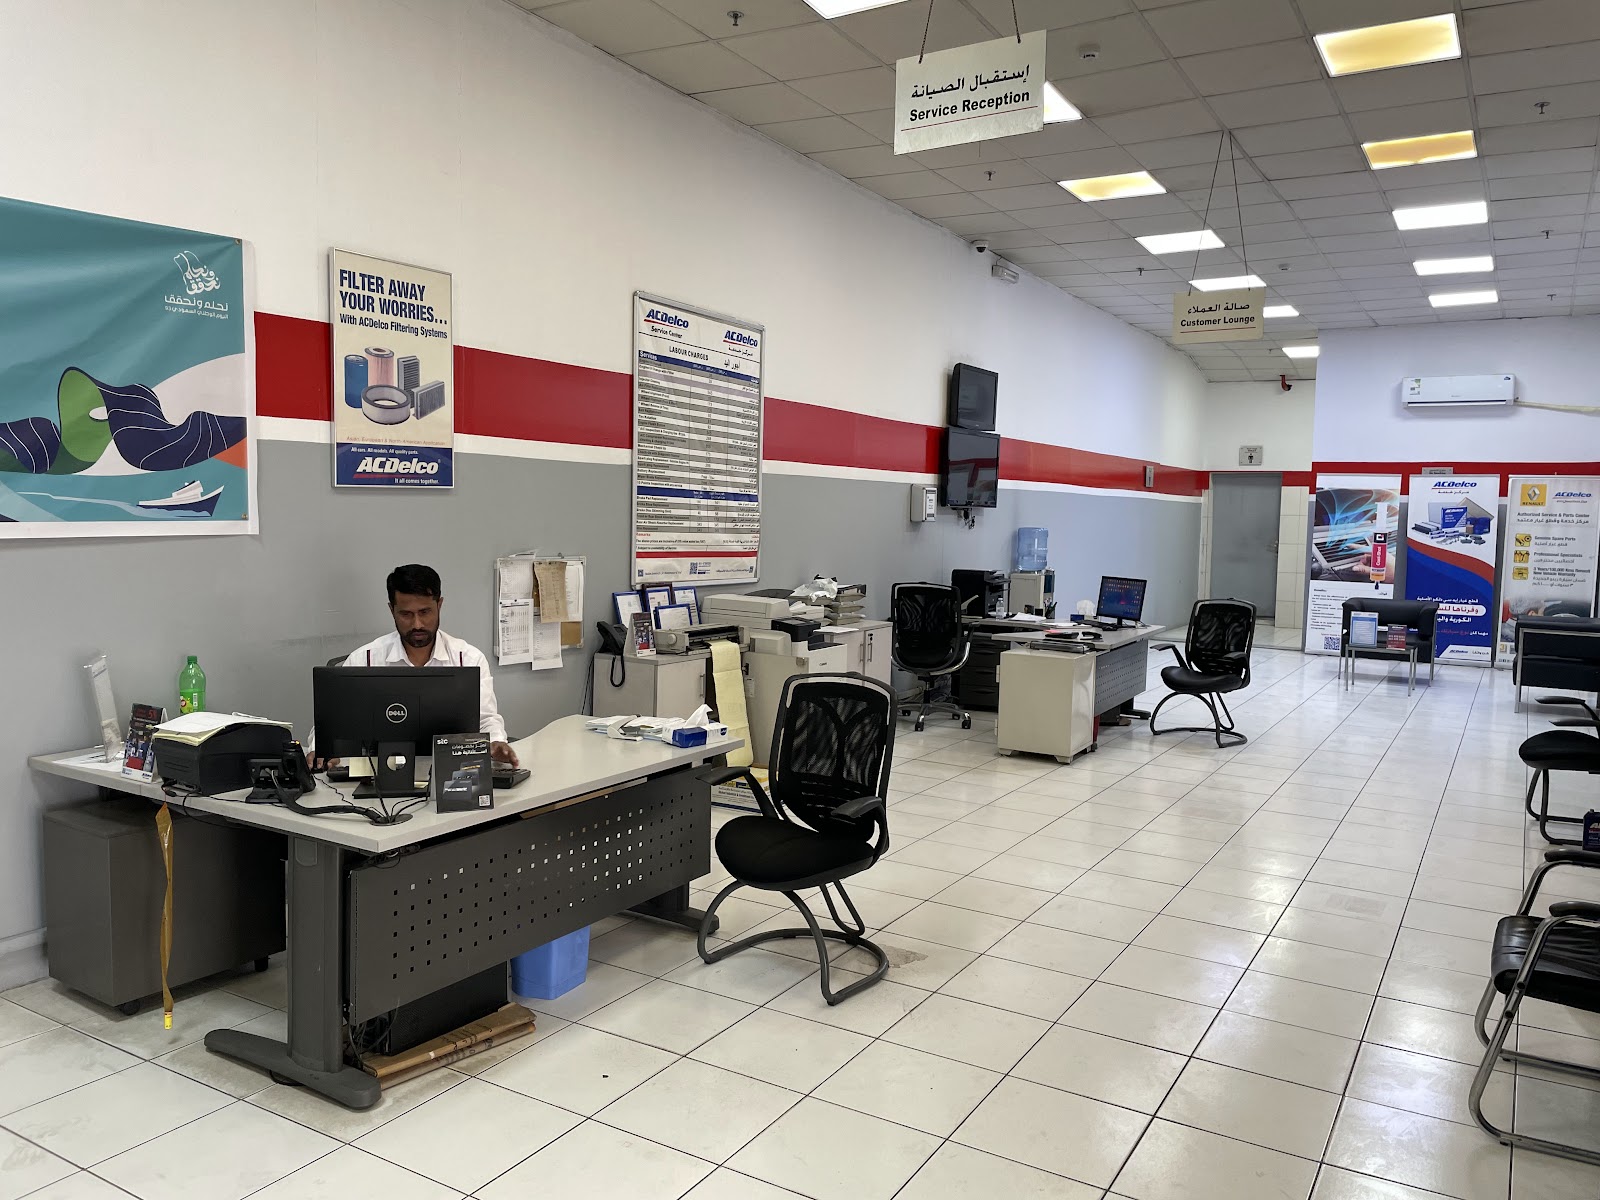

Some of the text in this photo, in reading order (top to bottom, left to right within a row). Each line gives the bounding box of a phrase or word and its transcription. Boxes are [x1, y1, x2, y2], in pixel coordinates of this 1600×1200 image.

[911, 64, 1030, 99] إستقبال الصيانة
[910, 91, 1030, 122] Service Reception
[340, 269, 425, 301] FILTER AWAY
[165, 294, 228, 312] نحلم ونحقق
[340, 290, 447, 324] YOUR WORRIES...
[1188, 302, 1250, 314] صالة العملاء
[340, 314, 447, 338] With ACDelco Filtering Systems
[646, 308, 689, 328] ACDelco
[1180, 318, 1221, 326] Customer
[651, 326, 668, 335] Service
[724, 330, 758, 347] ACDelco
[640, 351, 657, 360] Services
[669, 346, 708, 360] LABOUR CHARGES
